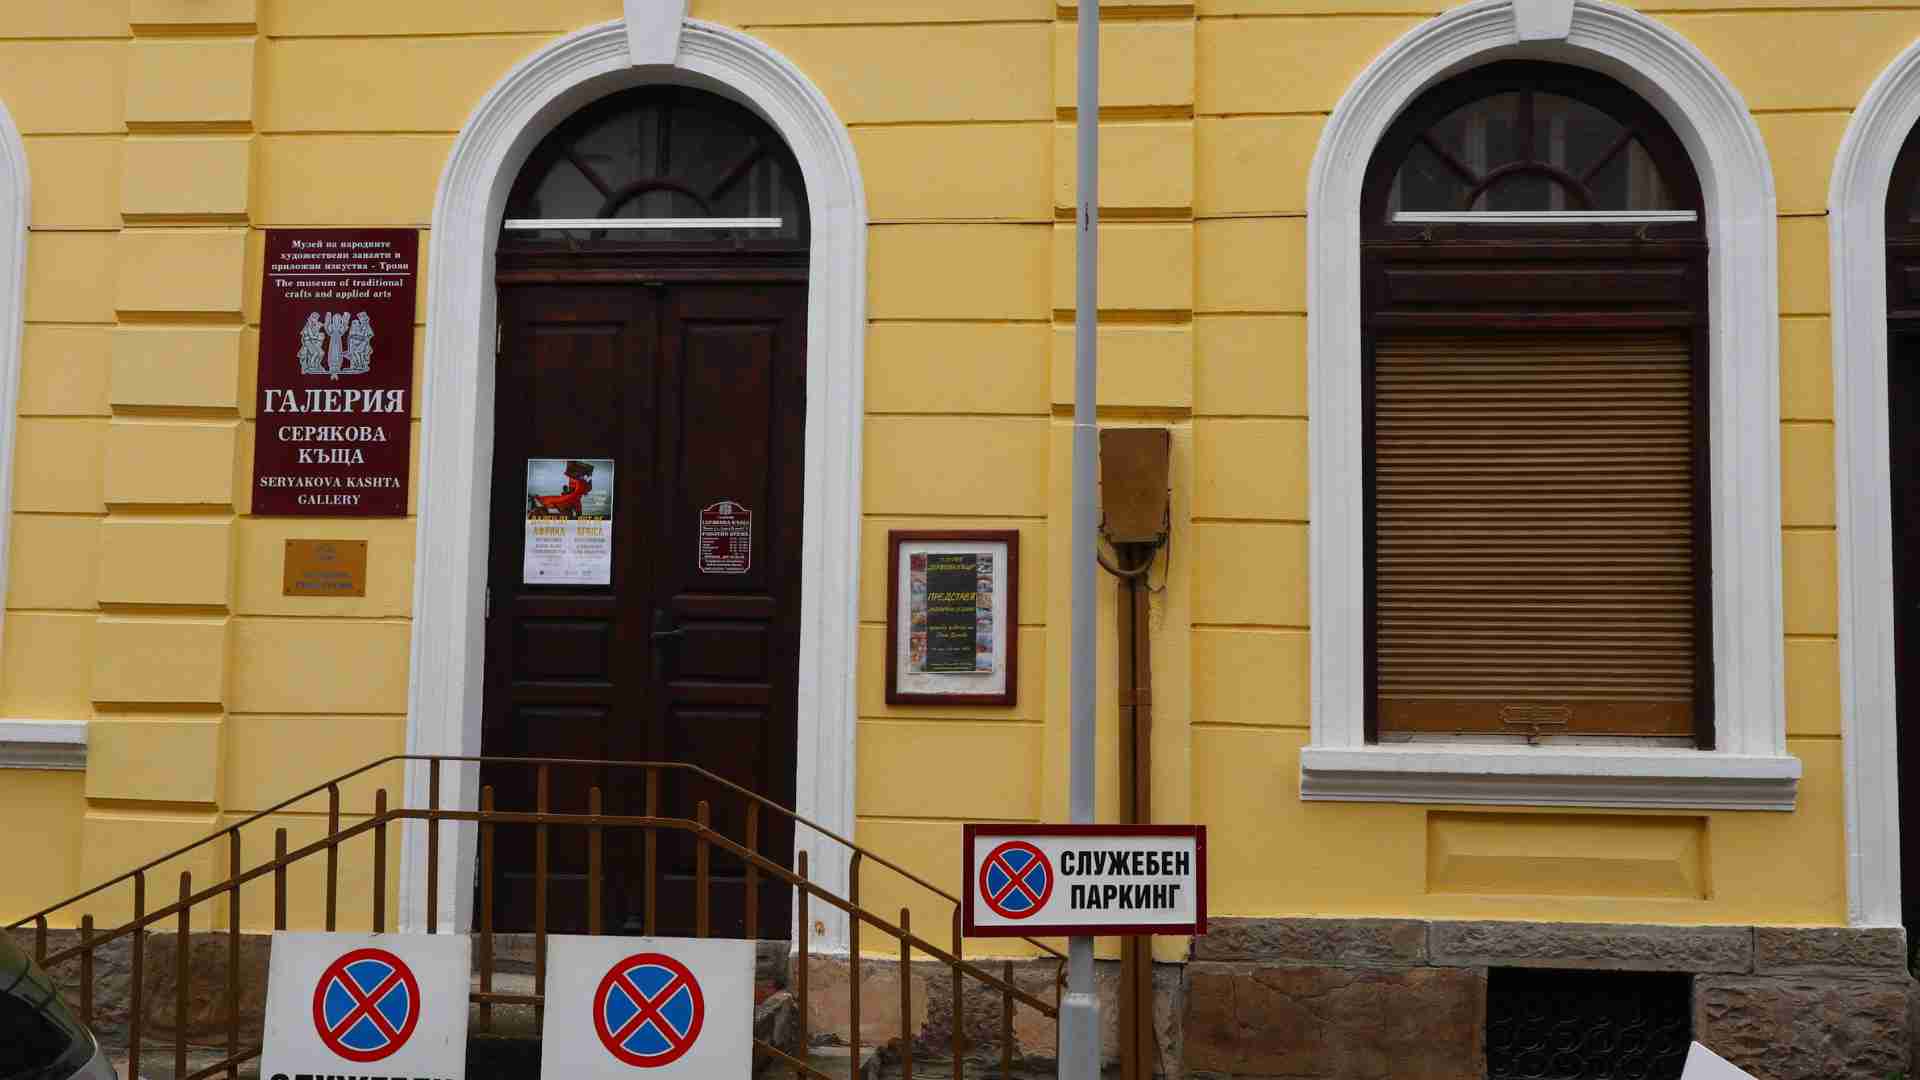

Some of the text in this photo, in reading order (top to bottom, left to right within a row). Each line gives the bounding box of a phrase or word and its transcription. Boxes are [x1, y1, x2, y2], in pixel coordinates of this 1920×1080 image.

[292, 240, 322, 249] Музей
[275, 279, 294, 287] The
[339, 279, 349, 287] of
[353, 279, 403, 287] traditional
[285, 289, 392, 299] crafts and applied arts
[263, 389, 405, 413] ГАЛЕРИЯ
[278, 426, 387, 442] СЕРЯКОВА
[298, 449, 365, 467] КЪЩА
[260, 476, 401, 488] SERYAKOVA KASHTA
[297, 494, 361, 505] GALLERY
[1060, 850, 1190, 876] СЛУЖЕБЕН
[1071, 884, 1181, 910] ПАРКИНГ
